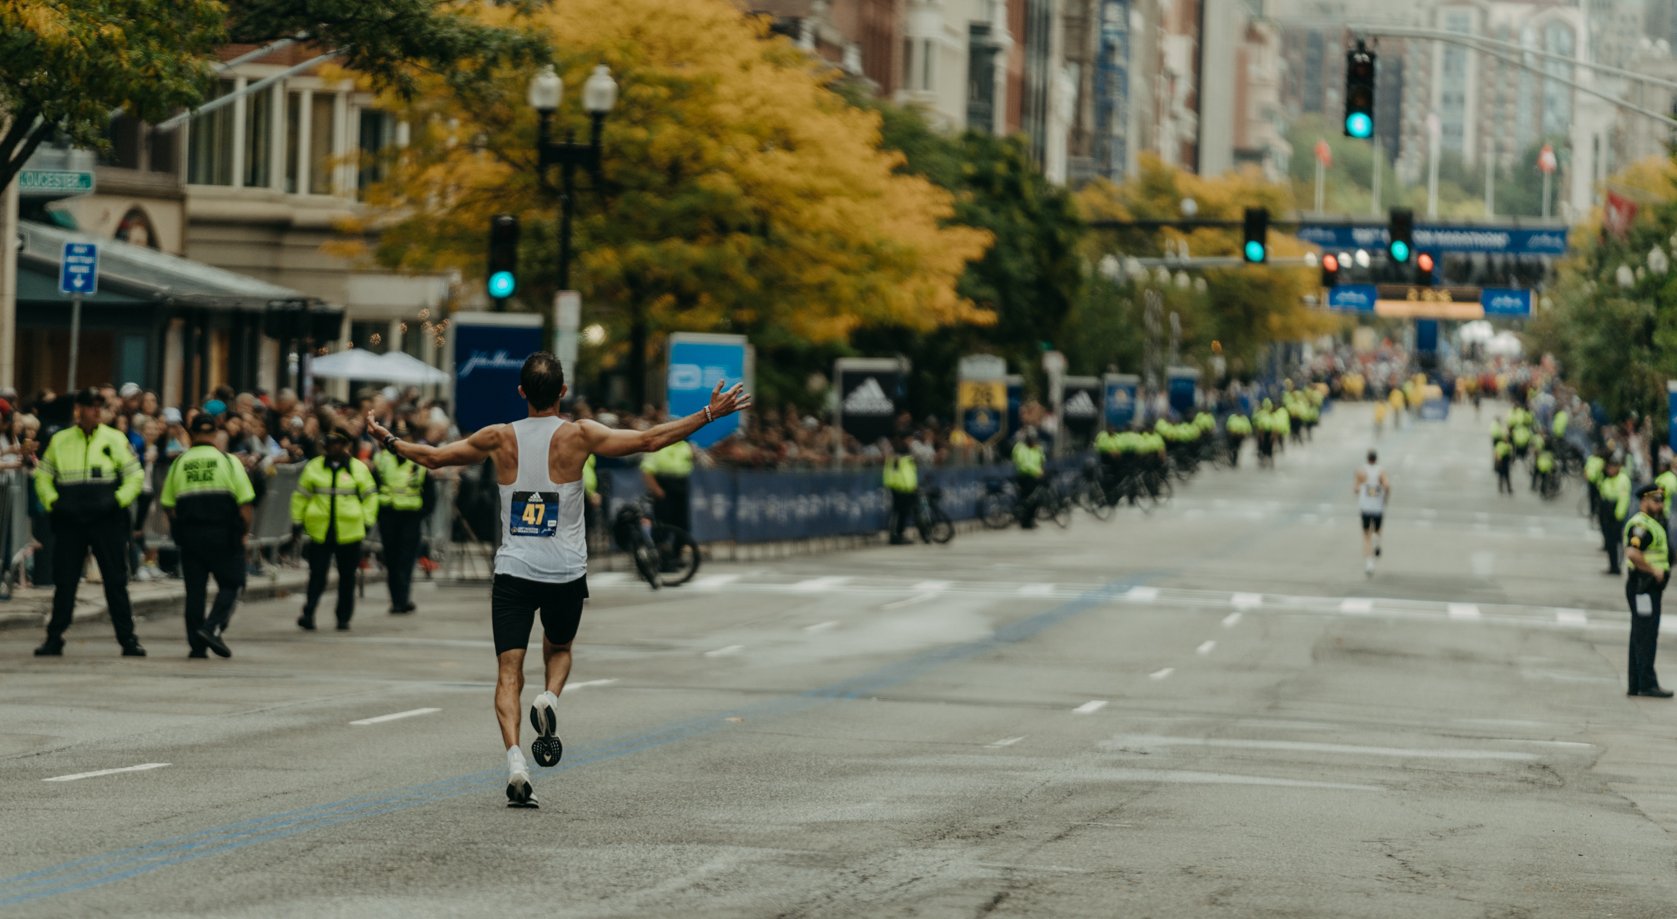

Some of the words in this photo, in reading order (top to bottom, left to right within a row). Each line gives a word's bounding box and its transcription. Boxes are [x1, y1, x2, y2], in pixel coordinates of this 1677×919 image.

[20, 172, 80, 188] LOUCESTER
[187, 470, 214, 482] POLICE
[522, 503, 545, 525] 47
